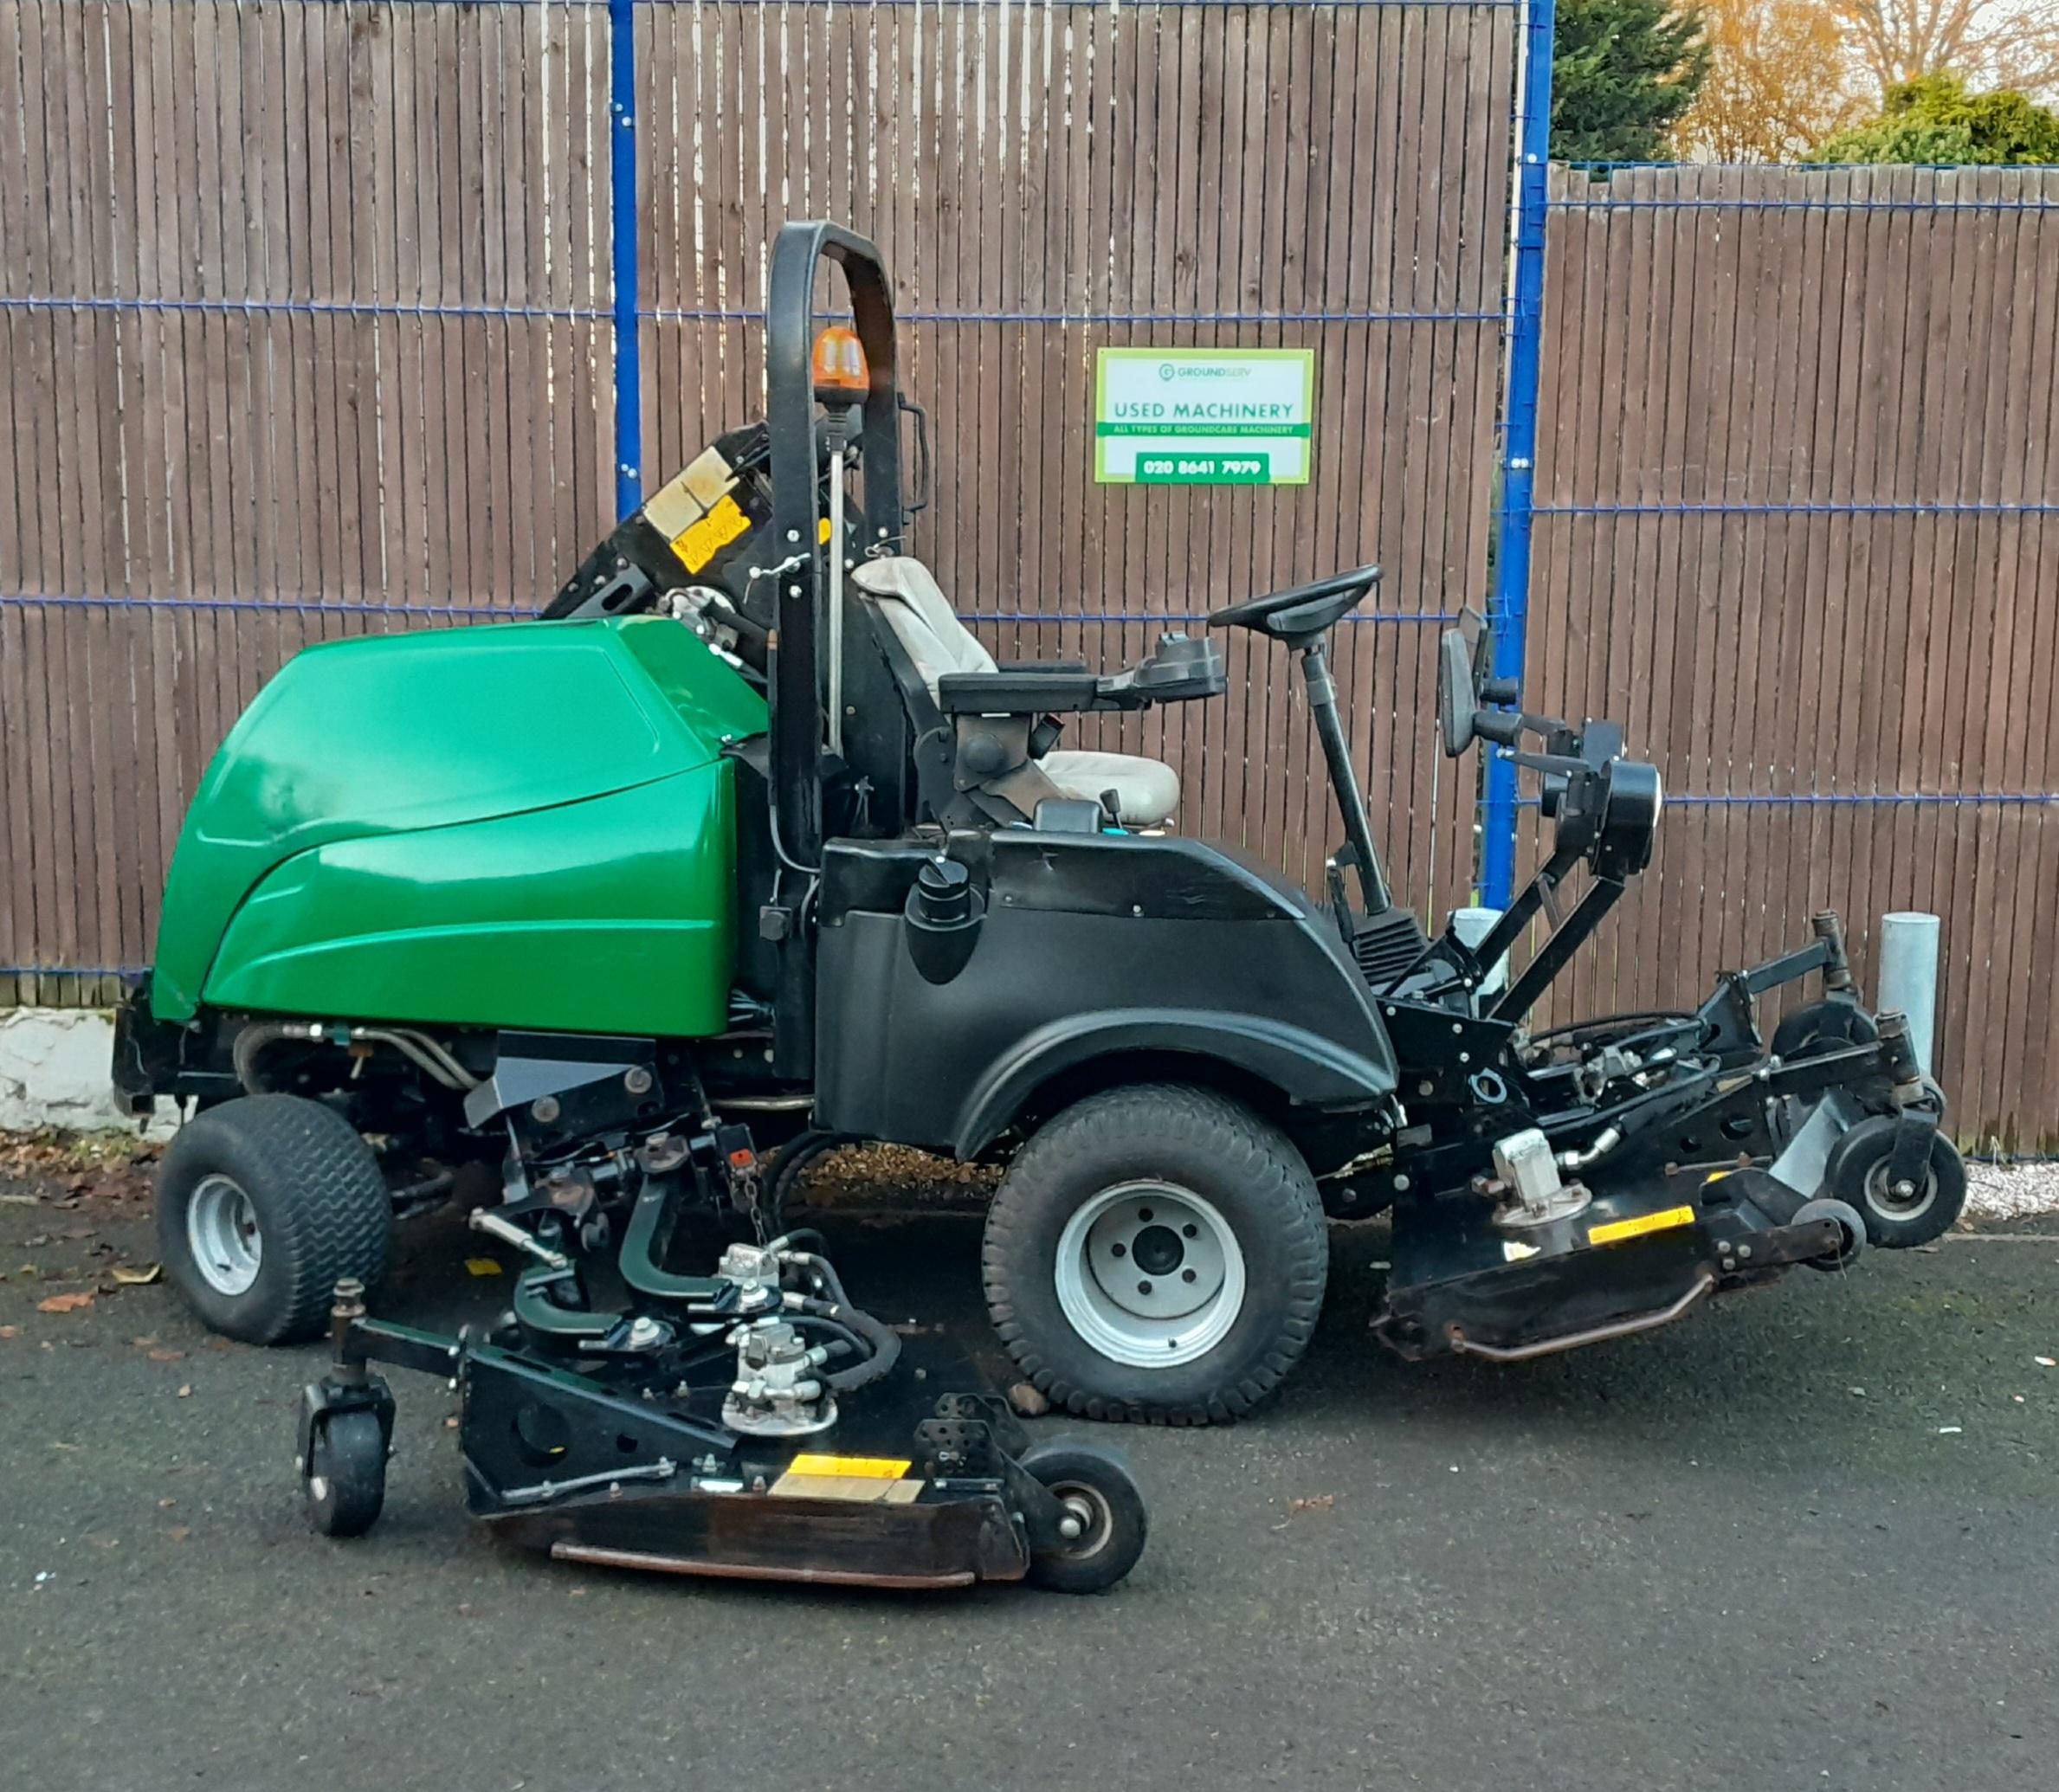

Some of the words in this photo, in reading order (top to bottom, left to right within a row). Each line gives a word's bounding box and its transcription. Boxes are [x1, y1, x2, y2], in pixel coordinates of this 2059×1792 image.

[1178, 367, 1253, 377] GROUNDSERV
[1114, 403, 1165, 417] USED
[1173, 403, 1294, 418] MACHINERY
[1174, 425, 1238, 434] GROUNDCARE
[1143, 460, 1174, 474] 020
[1178, 460, 1215, 474] 8641
[1221, 461, 1262, 475] 7979
